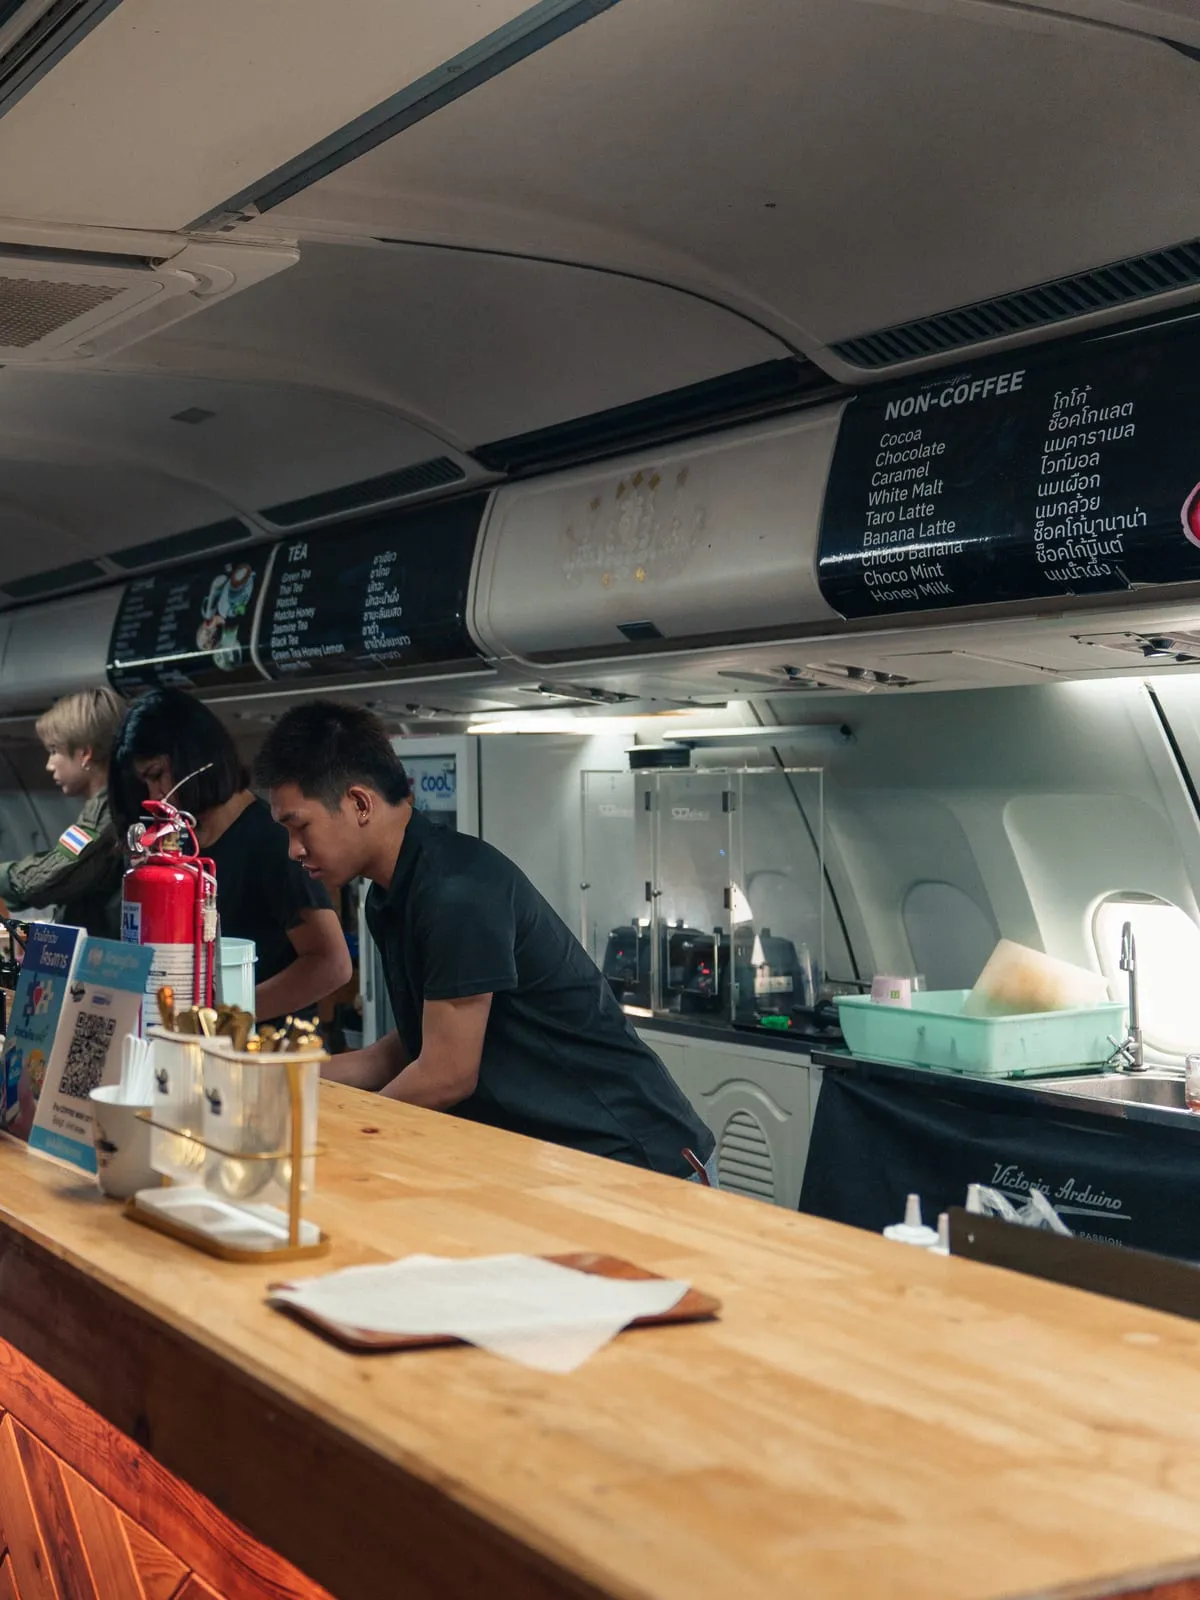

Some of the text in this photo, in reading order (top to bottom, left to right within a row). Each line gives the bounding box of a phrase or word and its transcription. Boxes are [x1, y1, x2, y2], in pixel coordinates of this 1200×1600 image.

[884, 370, 1026, 421] NON-COFFEE
[1053, 385, 1092, 411] โกโก้
[1048, 401, 1134, 432] ช็อคโกแลต
[879, 428, 922, 448] Cocoa
[1043, 423, 1136, 454] นมคาราเมล
[875, 441, 946, 468] Chocolate
[1040, 450, 1100, 475] ไวท์มอล
[871, 461, 930, 487] Caramel
[1038, 473, 1101, 497] นมเผือก
[868, 480, 944, 507] White Malt
[1035, 493, 1101, 519] นมกล้วย
[865, 503, 935, 527] Taro Latte
[863, 520, 956, 547] Banana Latte
[861, 541, 964, 567] Choco Banana
[864, 562, 945, 587] Choco Mint
[870, 581, 955, 602] Honey Milk
[302, 645, 323, 658] Honey
[322, 643, 345, 656] Lemon
[991, 1162, 1123, 1210] Victoria Arduino
